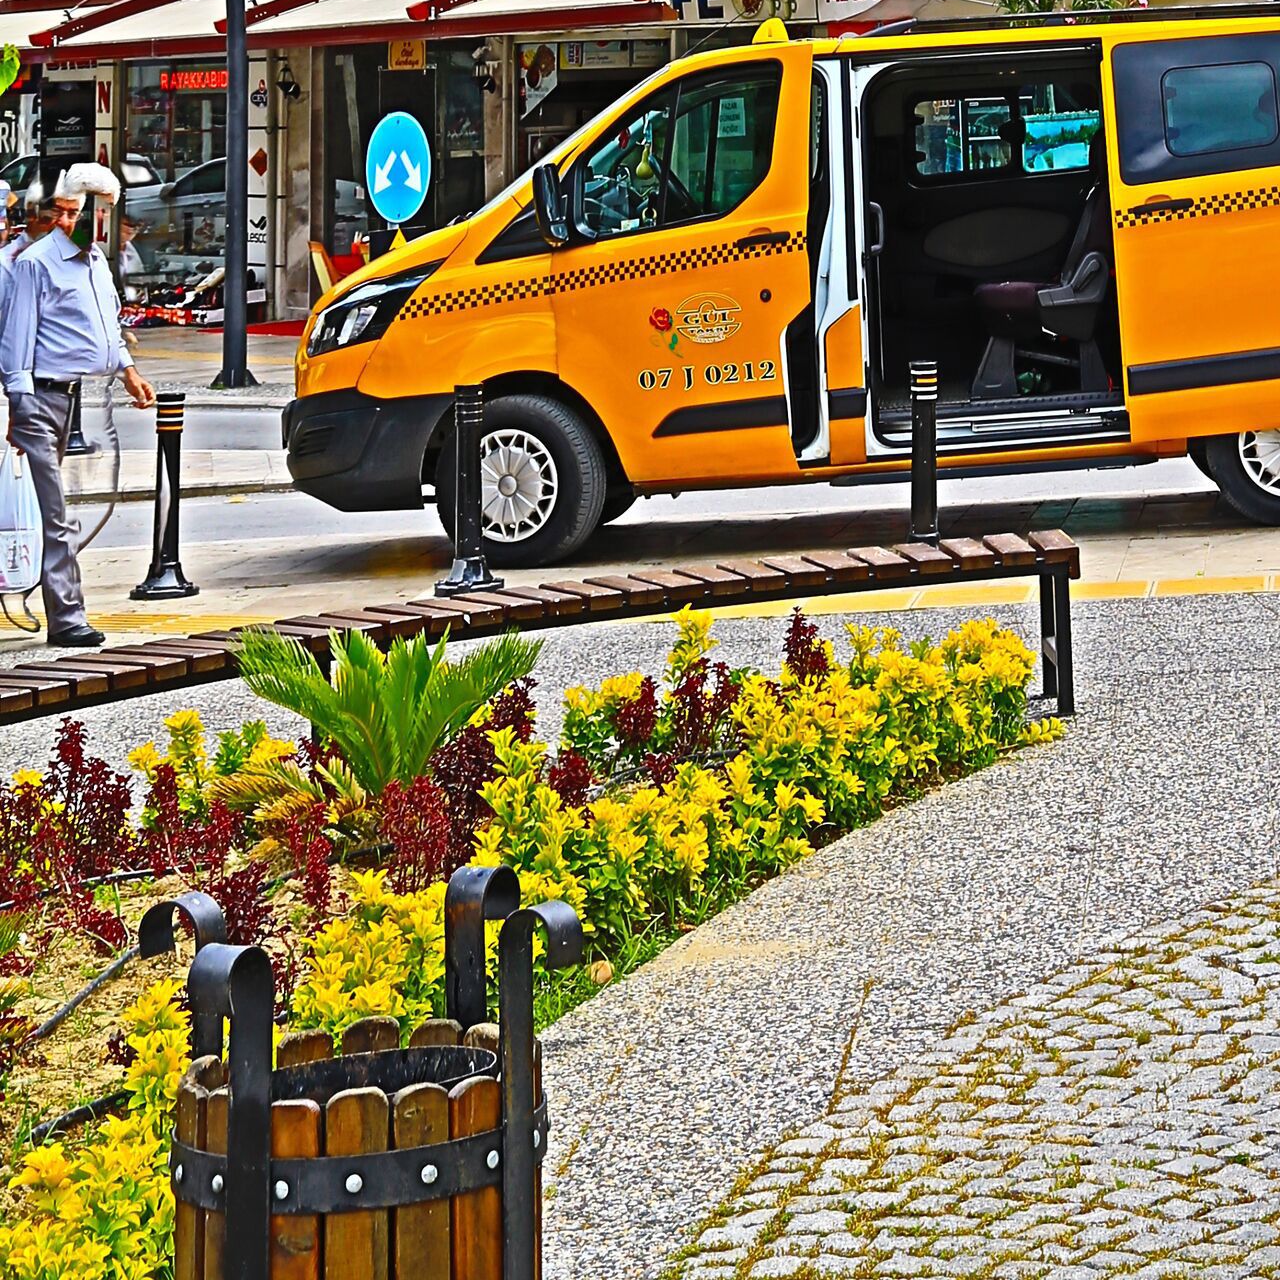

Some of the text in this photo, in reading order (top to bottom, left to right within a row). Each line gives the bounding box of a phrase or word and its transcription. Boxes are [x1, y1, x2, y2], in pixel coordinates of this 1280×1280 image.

[638, 360, 776, 390] 07 J 0212
